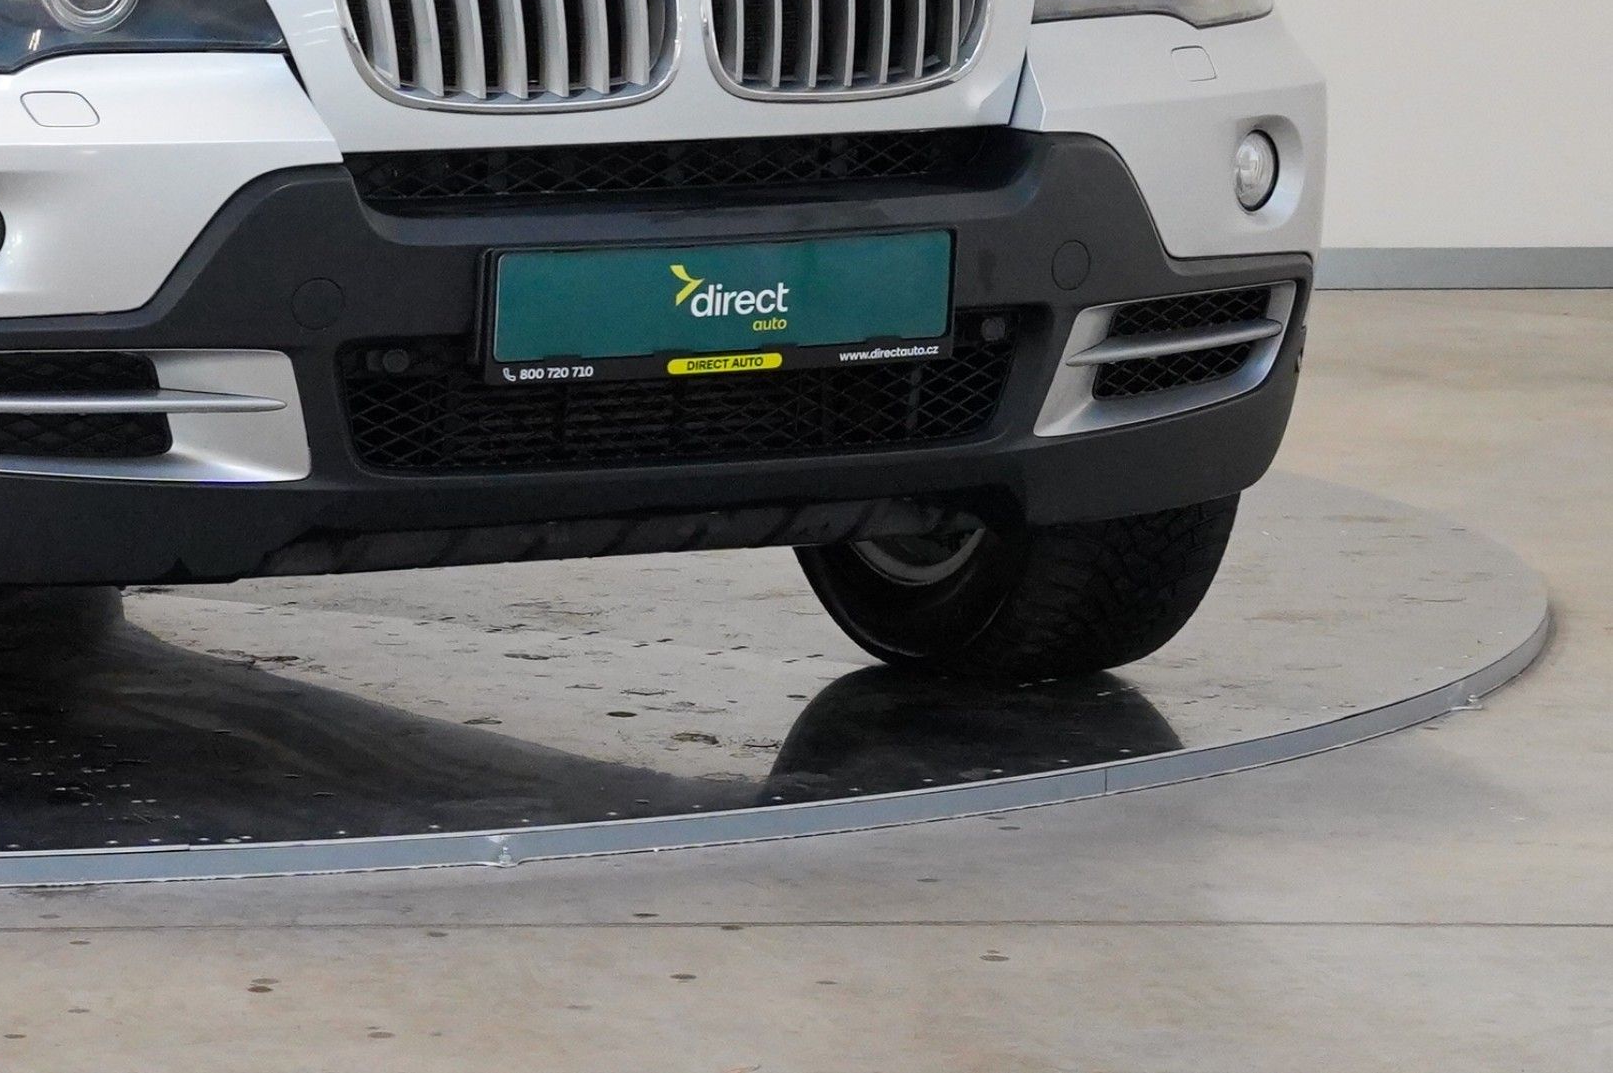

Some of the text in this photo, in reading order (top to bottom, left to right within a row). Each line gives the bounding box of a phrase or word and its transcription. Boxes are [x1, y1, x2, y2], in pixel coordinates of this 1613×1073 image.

[690, 282, 790, 317] direct
[752, 317, 787, 331] auto
[839, 345, 940, 362] www.directauto.cz
[687, 356, 764, 371] DIRECT AUTO
[519, 366, 594, 380] 800 720 710
